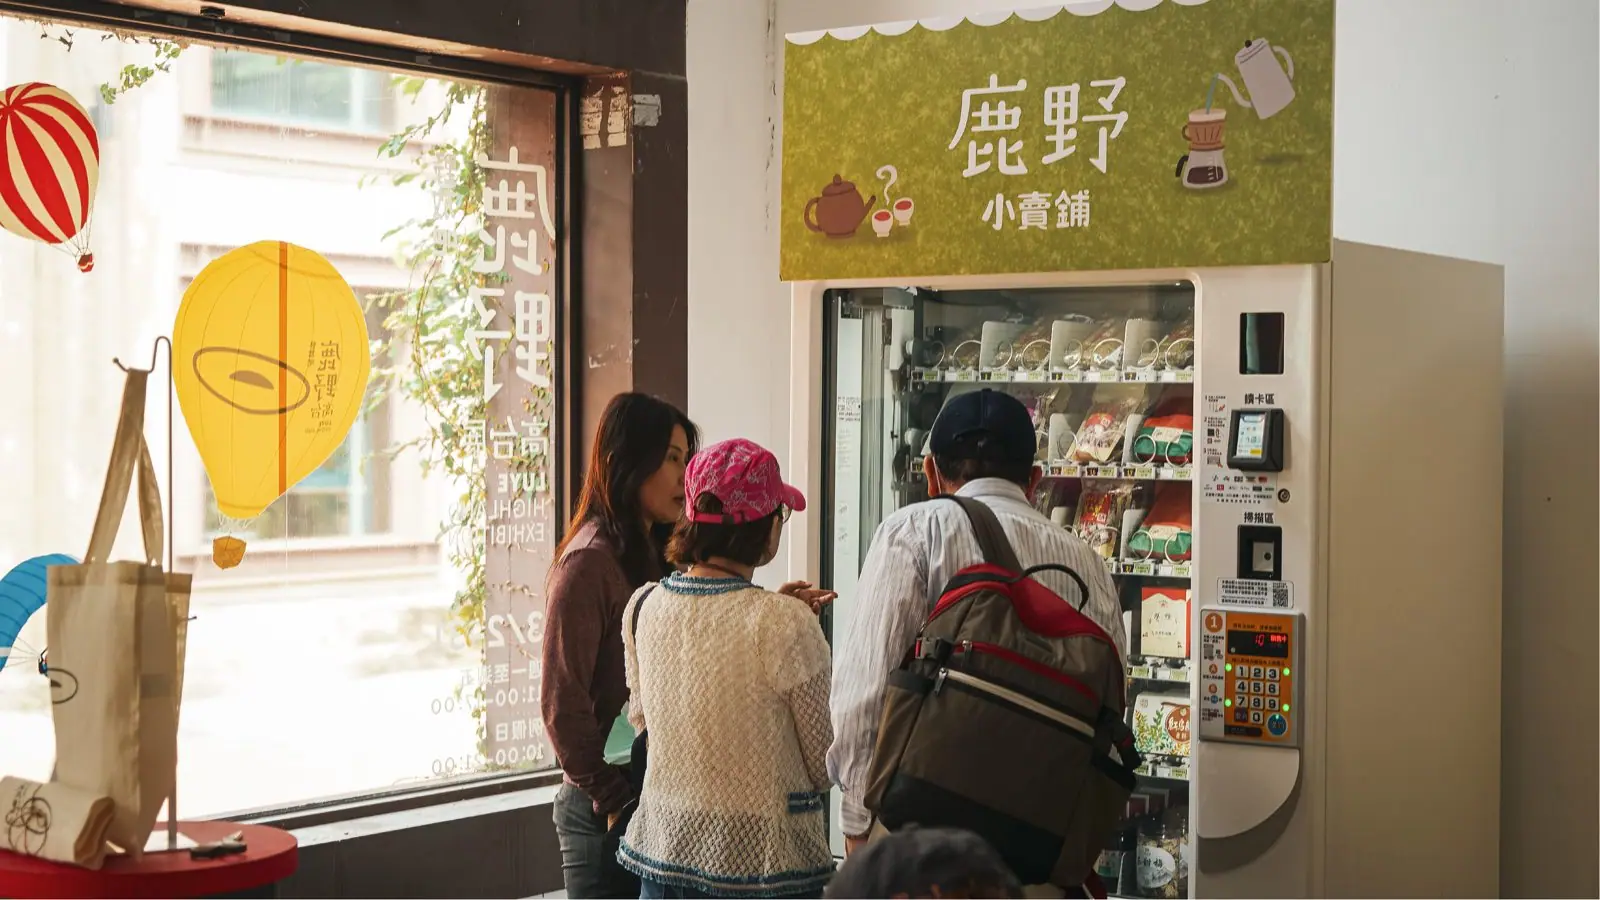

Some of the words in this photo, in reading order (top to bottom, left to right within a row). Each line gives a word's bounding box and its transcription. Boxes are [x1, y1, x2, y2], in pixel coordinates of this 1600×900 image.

[948, 73, 1129, 178] 鹿野
[981, 188, 1092, 231] 小賣鋪
[1210, 615, 1218, 629] 1
[1239, 666, 1244, 677] 1
[1253, 668, 1261, 677] 2
[1268, 669, 1277, 679] 3
[1237, 681, 1245, 691] 4
[1253, 682, 1261, 692] 5
[1268, 684, 1276, 693] 6
[1237, 697, 1245, 706] 7
[1253, 698, 1261, 707] 8
[1268, 699, 1276, 709] 9
[1252, 712, 1260, 722] 0
